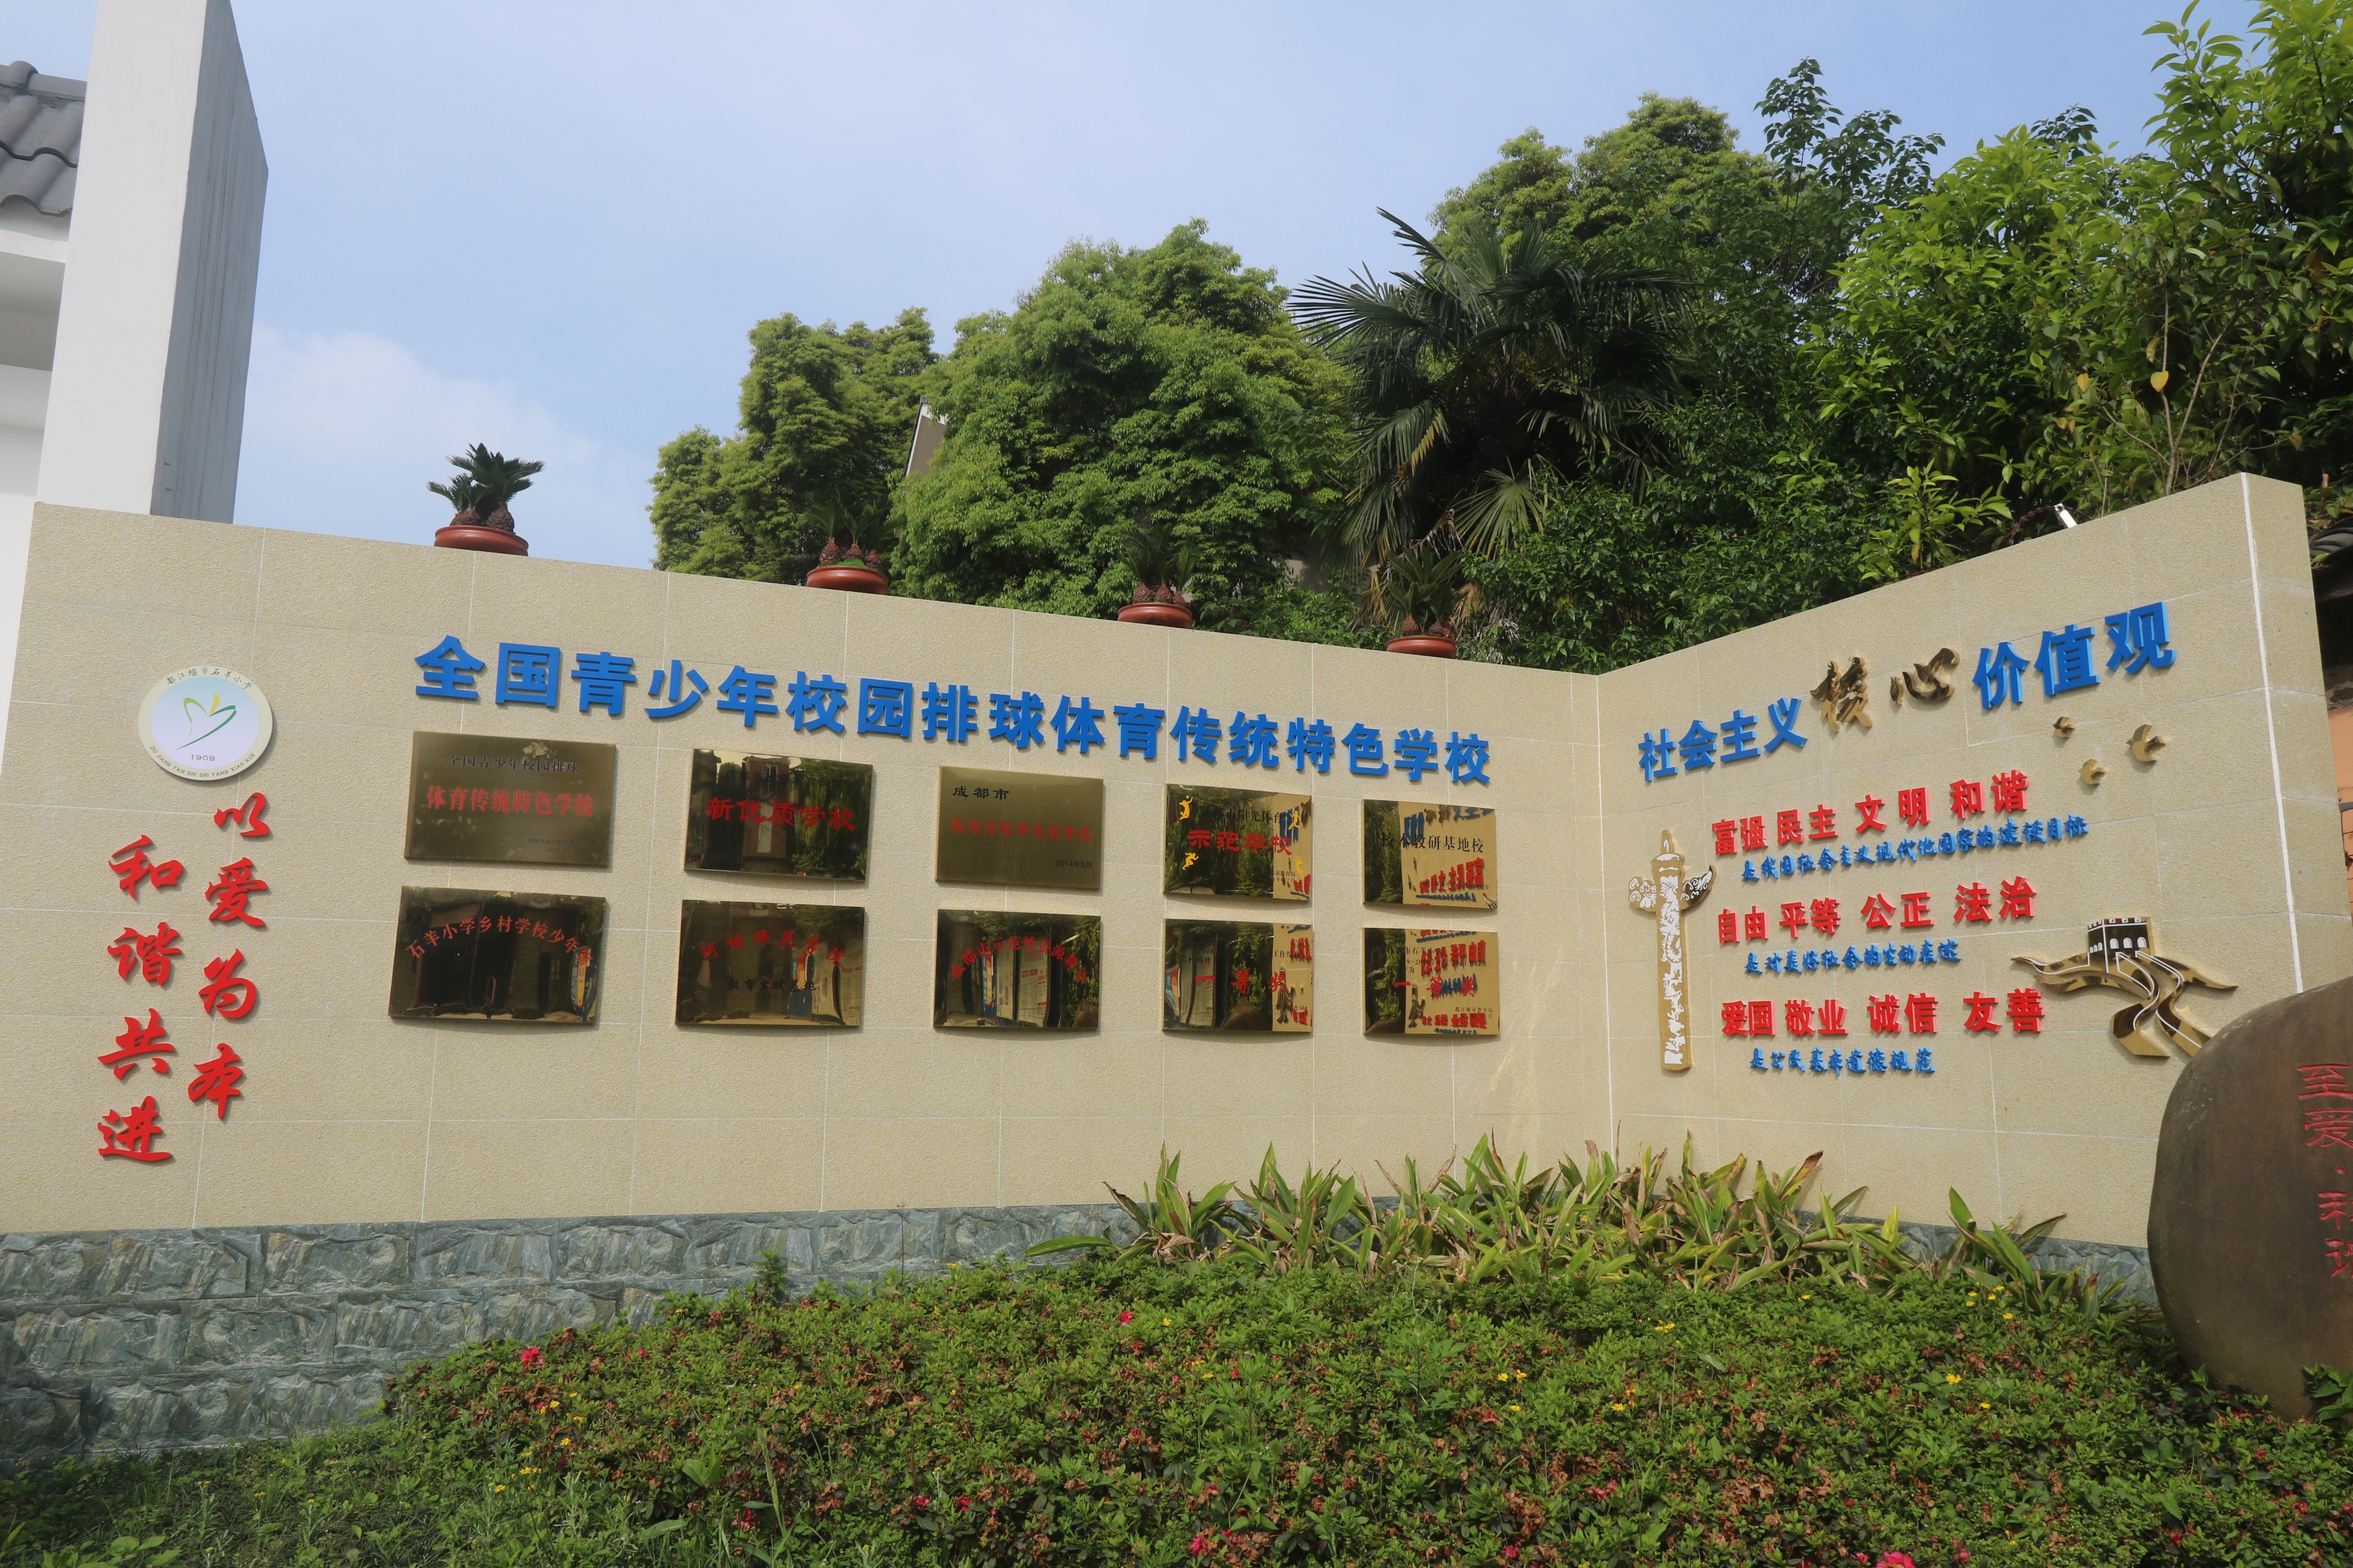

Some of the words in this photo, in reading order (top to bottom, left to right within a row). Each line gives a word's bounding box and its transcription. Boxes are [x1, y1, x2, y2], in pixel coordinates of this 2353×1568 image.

[166, 666, 253, 689] 都江堰市石羊小学
[1639, 602, 2177, 782] 社会主义核心价值观
[414, 635, 1490, 784] 全国青少年校园排球体育传统特色学校
[156, 750, 171, 767] JIANG
[173, 765, 185, 774] YAN
[230, 762, 244, 772] XIAO
[244, 752, 256, 763] XUE
[450, 754, 579, 773] 全国青少年校园排球
[427, 785, 594, 816] 体育传统特色学校
[952, 785, 1010, 800] 成都市
[704, 797, 856, 831] 新优质学校
[1712, 816, 1767, 855] 富强
[1777, 804, 1838, 845] 民主
[1855, 787, 1930, 834] 文明
[1949, 769, 2029, 819] 和谐
[1188, 829, 1293, 855] 示范学校
[1382, 832, 1484, 853] 校本教研基地校
[1742, 815, 2088, 881] 是我国社会主义现代化国家的建设目标
[1055, 860, 1092, 869] 2014年5月
[1718, 905, 1768, 943] 自由
[1779, 898, 1840, 938] 平等
[1860, 892, 1934, 928] 公正
[1954, 876, 2037, 922] 法治
[188, 792, 270, 1120] 以爱为本
[1745, 939, 1961, 974] 是对美好社会的生动表述
[1195, 968, 1287, 994] 一等奖
[1392, 973, 1478, 999] 一等奖
[97, 835, 183, 1163] 和谐共进
[1721, 1000, 1776, 1036] 爱国
[1784, 999, 1848, 1036] 敬业
[1867, 993, 1938, 1033] 诚信
[1963, 988, 2045, 1033] 友善
[1750, 1047, 1935, 1074] 是公民基本道德规范
